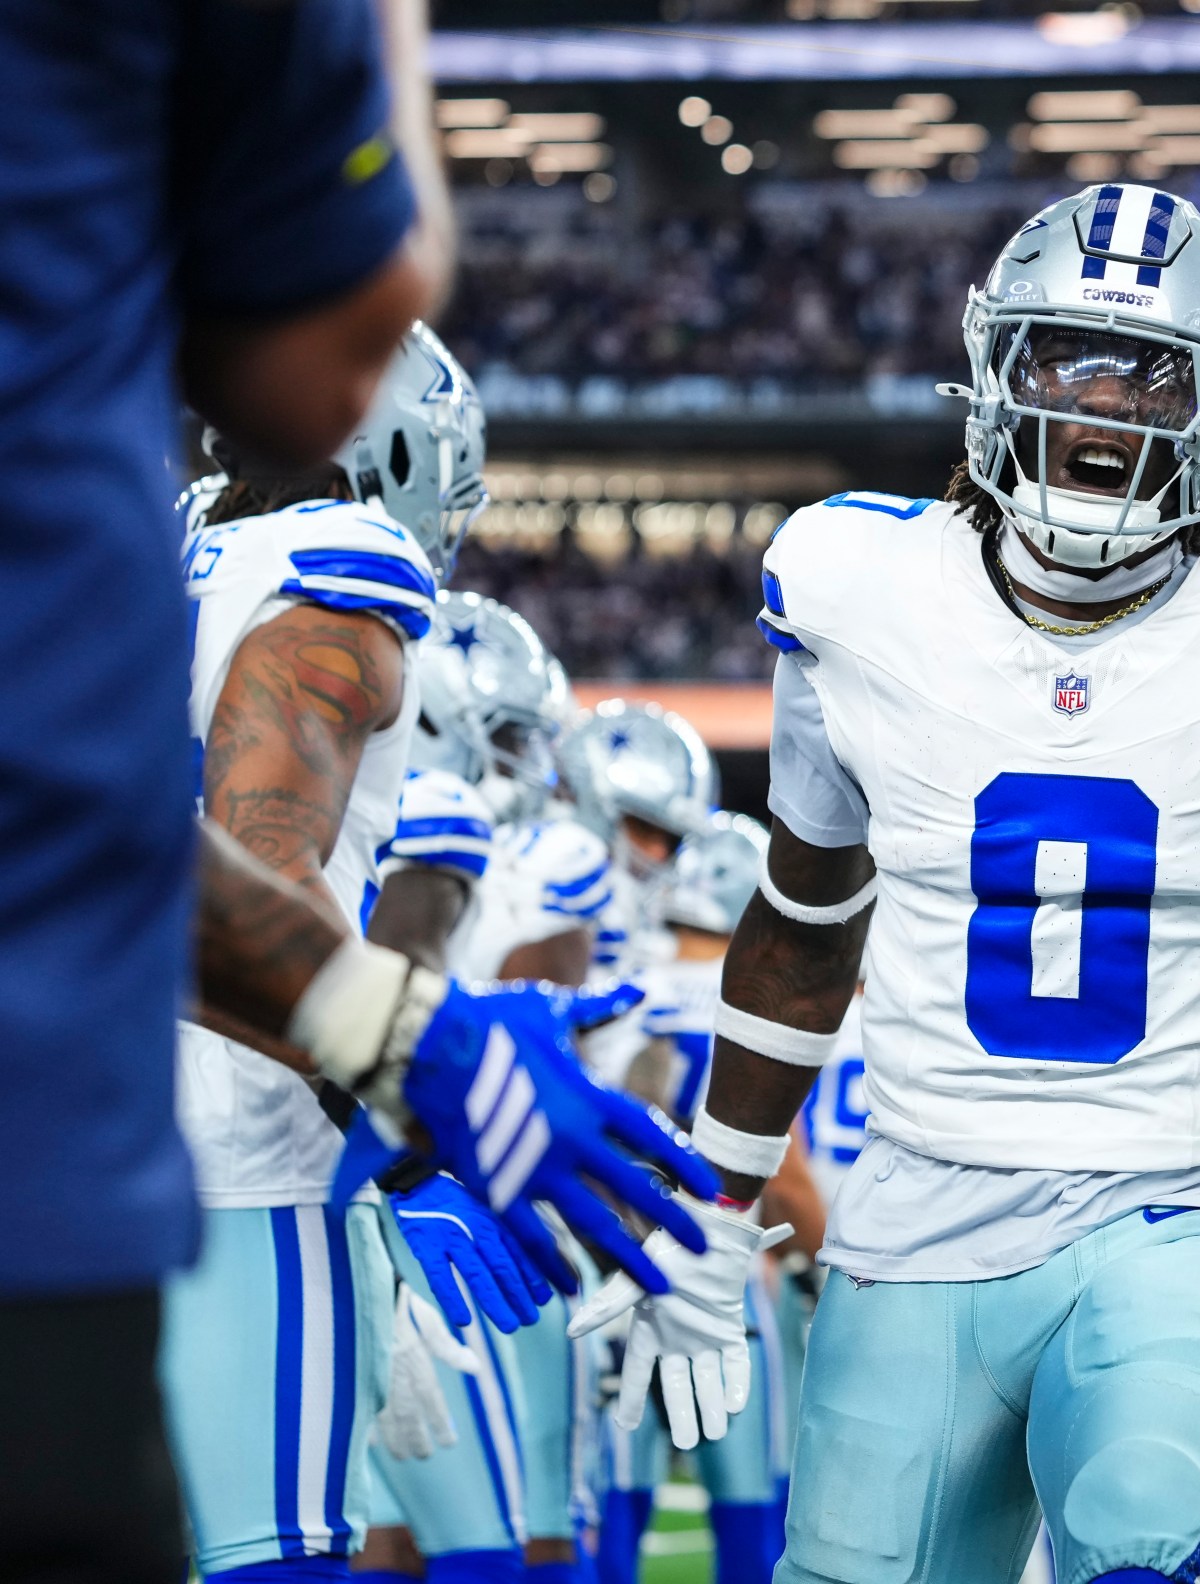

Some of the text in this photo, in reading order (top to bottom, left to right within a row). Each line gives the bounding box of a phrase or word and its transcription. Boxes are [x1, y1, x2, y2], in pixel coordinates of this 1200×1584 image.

[1083, 288, 1154, 308] COWBOYS
[1058, 690, 1084, 710] NFL
[965, 772, 1160, 1064] 0
